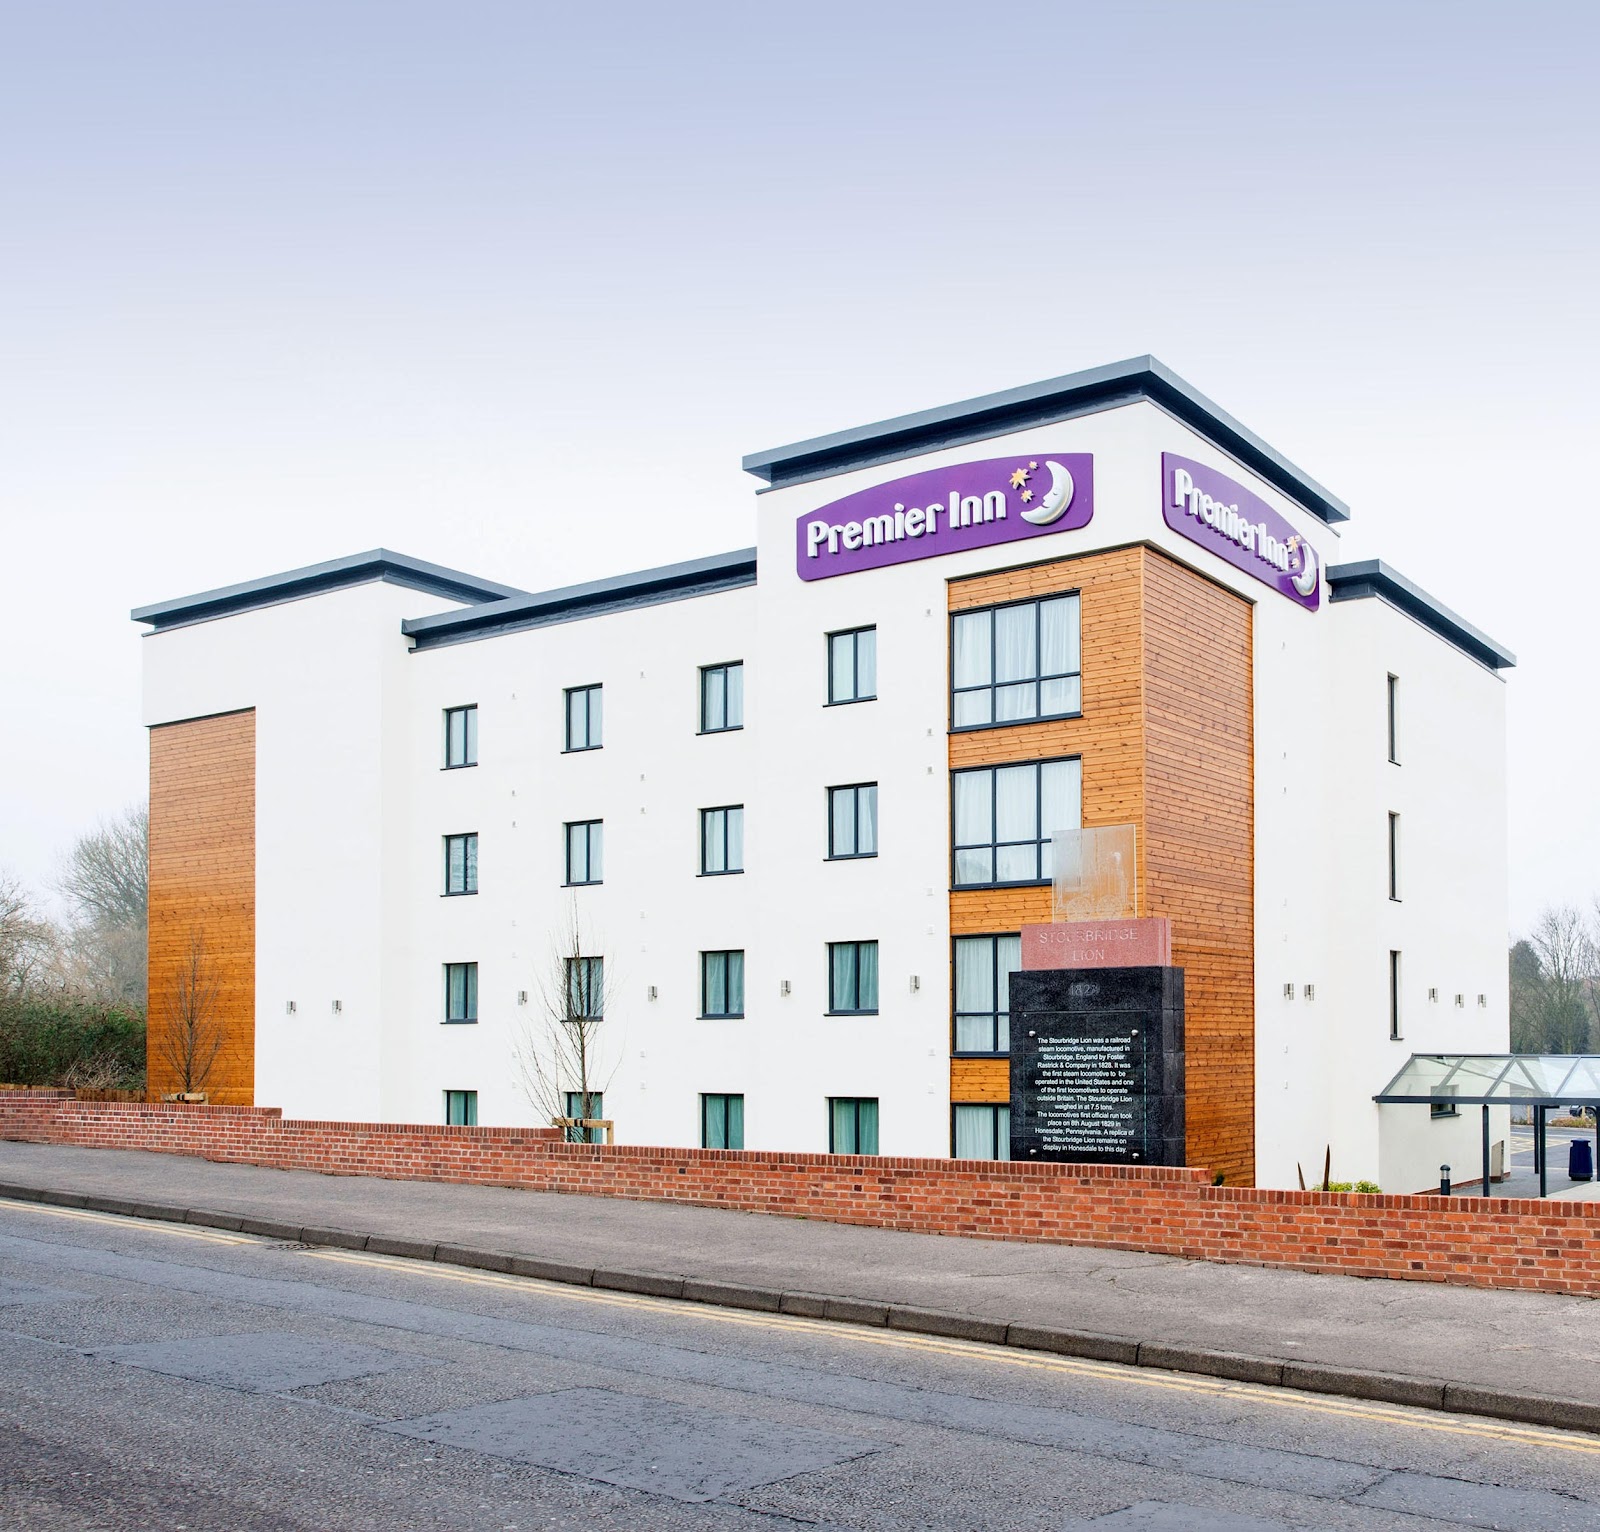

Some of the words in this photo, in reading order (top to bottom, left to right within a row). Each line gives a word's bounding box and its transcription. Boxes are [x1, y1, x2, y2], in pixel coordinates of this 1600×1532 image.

[807, 503, 945, 557] Premier
[949, 490, 1006, 528] Inn
[1174, 468, 1258, 550] Premier
[1258, 523, 1289, 571] Inn
[1073, 949, 1105, 961] LION
[1052, 1136, 1082, 1144] Stourbridge
